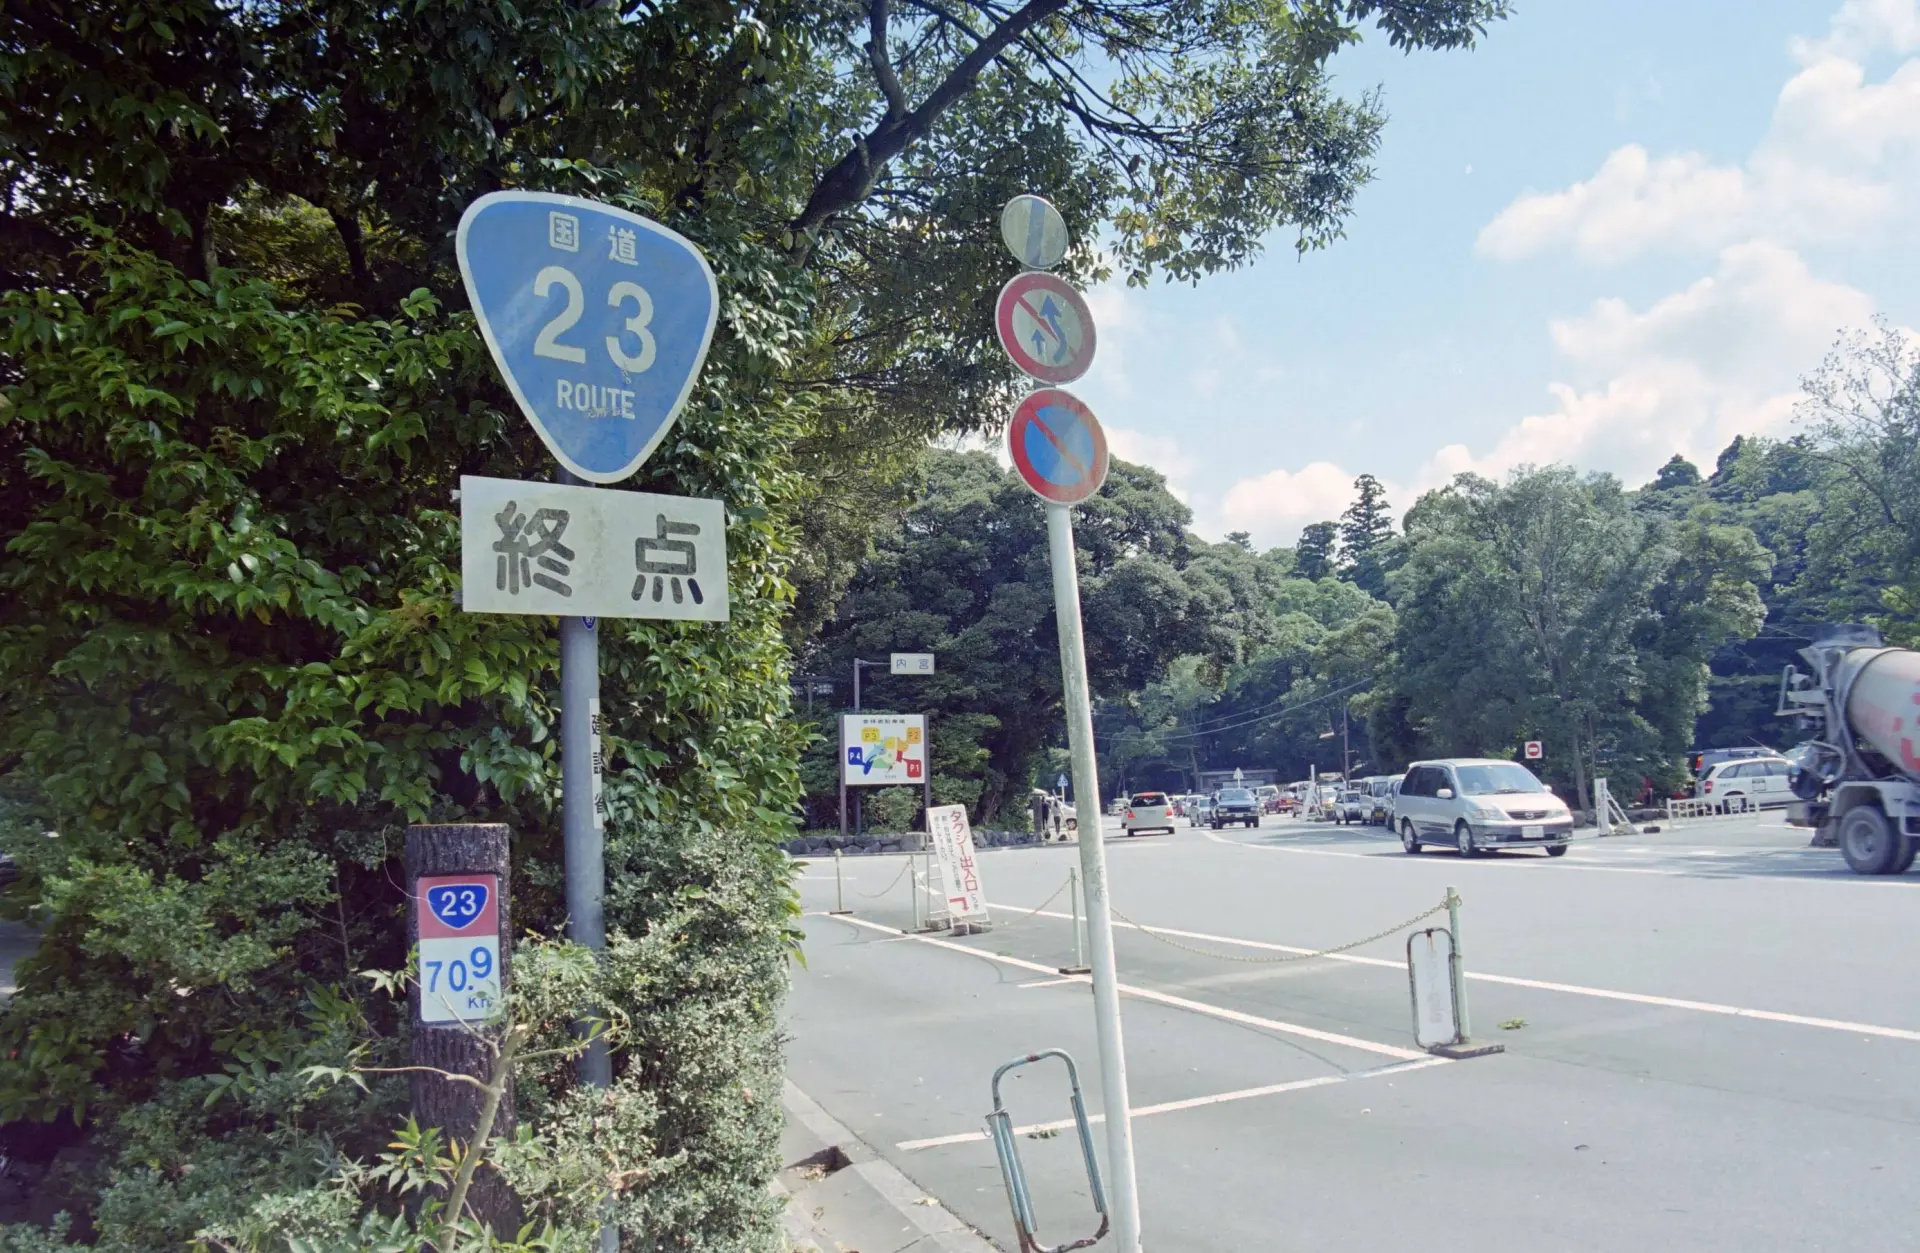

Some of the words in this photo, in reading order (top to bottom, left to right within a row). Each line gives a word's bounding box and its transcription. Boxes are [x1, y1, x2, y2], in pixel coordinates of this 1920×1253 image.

[549, 210, 638, 266] 国道
[533, 265, 657, 373] 23
[557, 379, 636, 420] ROUTE
[492, 500, 704, 605] 終点
[909, 764, 920, 773] P1
[441, 891, 477, 916] 23
[425, 946, 492, 993] 70.9
